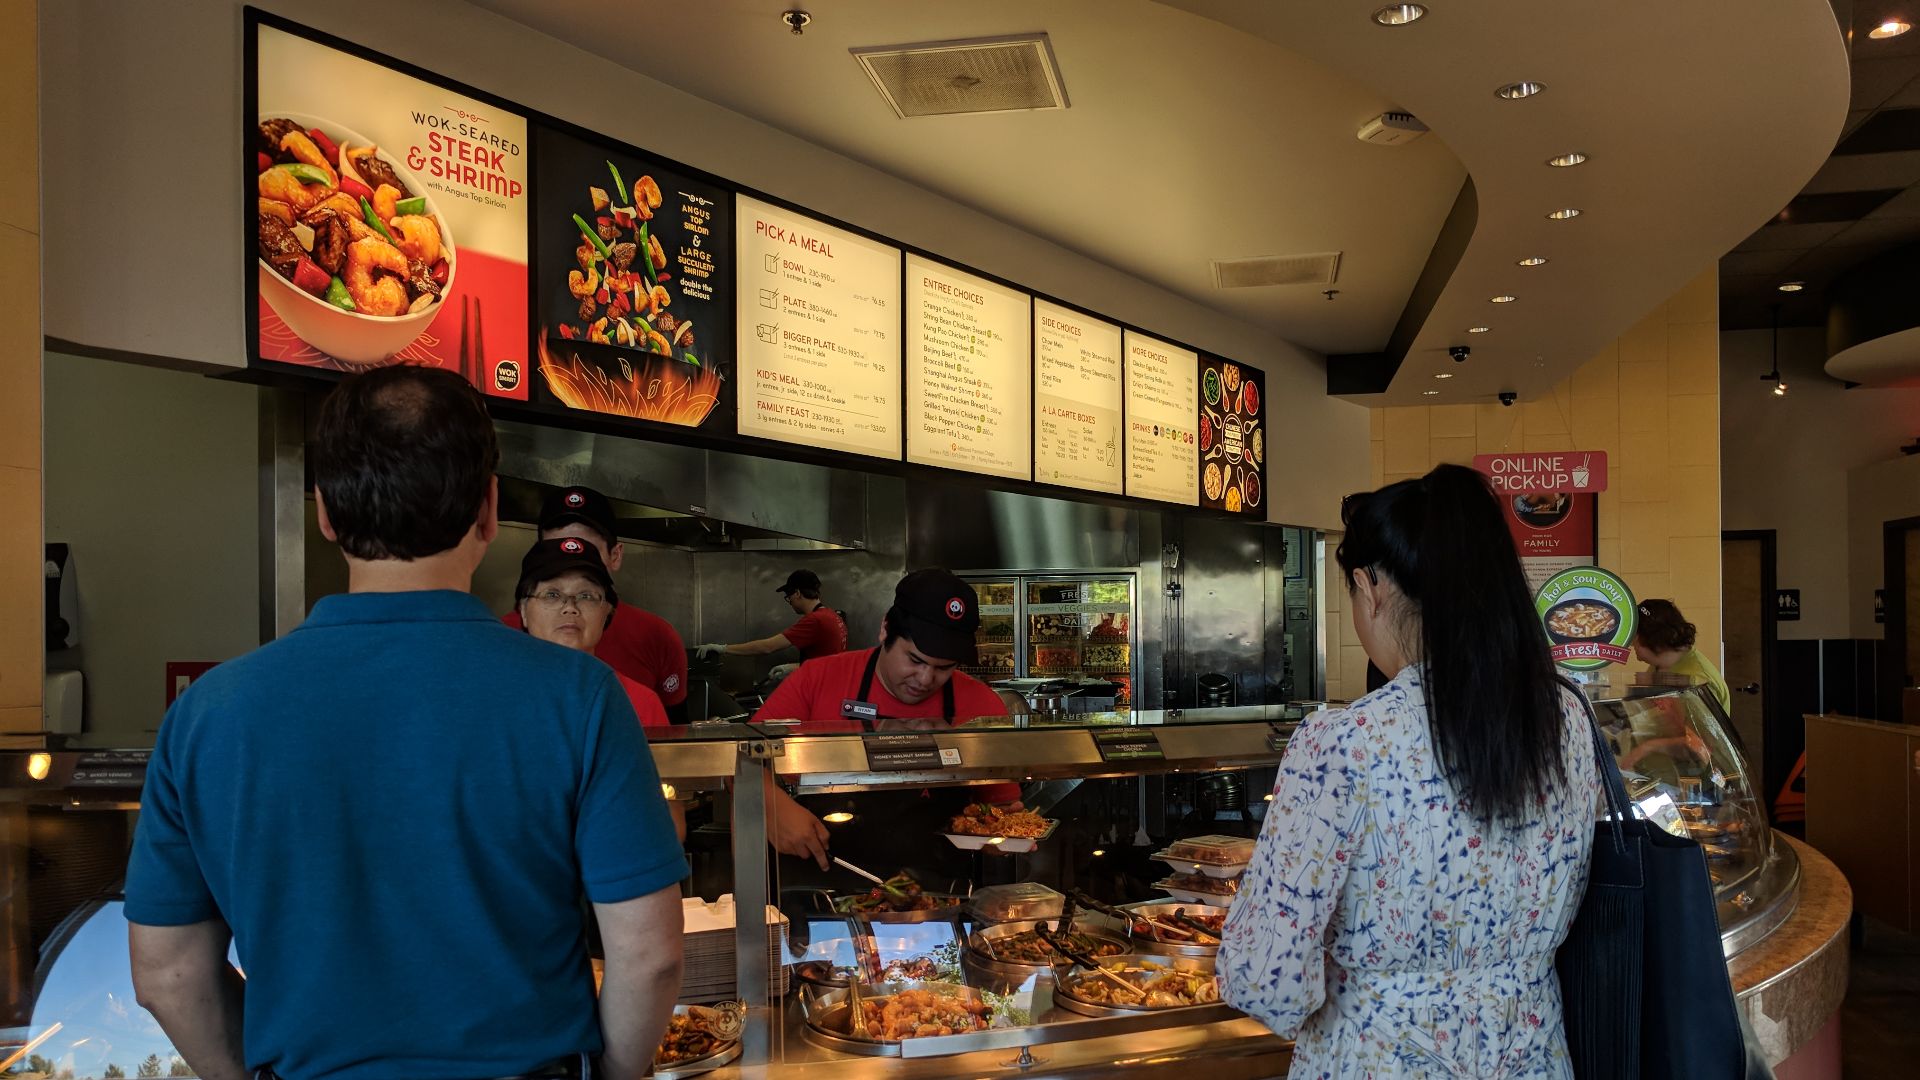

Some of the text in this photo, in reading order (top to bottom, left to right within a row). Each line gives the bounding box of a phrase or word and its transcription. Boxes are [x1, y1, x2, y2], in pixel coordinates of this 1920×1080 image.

[411, 111, 519, 156] WOK-SEARED
[428, 131, 505, 173] STEAK
[407, 146, 523, 199] & SHRIMP
[427, 181, 507, 209] with Angus Top Sirloin
[681, 204, 710, 221] ANGUS
[690, 215, 704, 225] TOP
[683, 221, 709, 236] SIRLOIN
[692, 234, 701, 247] &
[756, 220, 834, 259] PICK A MEAL
[680, 246, 712, 263] LARGE
[677, 255, 715, 273] SUCCULENT
[683, 266, 709, 278] SHRIMP
[783, 259, 806, 275] BOWL
[680, 277, 713, 293] double the
[783, 270, 786, 278] 1
[812, 280, 822, 288] side
[683, 286, 710, 300] delicious
[923, 277, 952, 295] ENTREE
[953, 287, 984, 306] CHOICES
[783, 294, 807, 310] PLATE
[923, 300, 942, 313] Orange
[942, 306, 962, 318] Chicken
[783, 306, 787, 314] 2
[807, 312, 812, 320] &
[816, 315, 826, 324] side
[923, 311, 939, 322] String
[939, 316, 952, 326] Bean
[952, 321, 972, 332] Chicken
[923, 322, 966, 341] Kung Pao Chicken
[1041, 316, 1056, 329] SIDE
[1056, 321, 1082, 337] CHOICES
[783, 330, 812, 346] BIGGER
[813, 337, 836, 352] PLATE
[923, 334, 969, 352] Mushroom Chicken
[807, 347, 812, 355] &
[923, 344, 953, 359] Beijing Beef
[1132, 346, 1168, 365] MORE CHOICES
[923, 355, 944, 367] Broccoli
[499, 368, 516, 377] WOK
[756, 368, 777, 382] KID'S
[779, 373, 801, 387] MEAL
[923, 367, 947, 379] Shanghai
[947, 372, 963, 383] Angus
[923, 378, 940, 389] Honey
[813, 392, 826, 401] drink
[826, 394, 831, 402] &
[949, 395, 970, 406] Chicken
[970, 400, 986, 410] Breast
[757, 400, 785, 414] FAMILY
[785, 405, 810, 419] FEAST
[960, 410, 980, 421] Chicken
[1042, 405, 1096, 425] A LA CARTE BOXES
[757, 412, 761, 420] 3
[762, 414, 768, 422] lg
[768, 416, 787, 425] entrees
[793, 419, 798, 427] 2
[798, 421, 804, 429] lg
[804, 422, 817, 430] sides
[938, 416, 956, 426] Pepper
[1132, 422, 1151, 434] DRINKS
[1490, 456, 1564, 473] ONLINE
[1523, 540, 1560, 548] FAMILY
[1061, 592, 1088, 600] FRES
[1542, 575, 1623, 603] hot & sour soup
[1058, 604, 1098, 613] VEGGIES
[1564, 642, 1600, 658] fresh
[1602, 648, 1623, 658] DAILY
